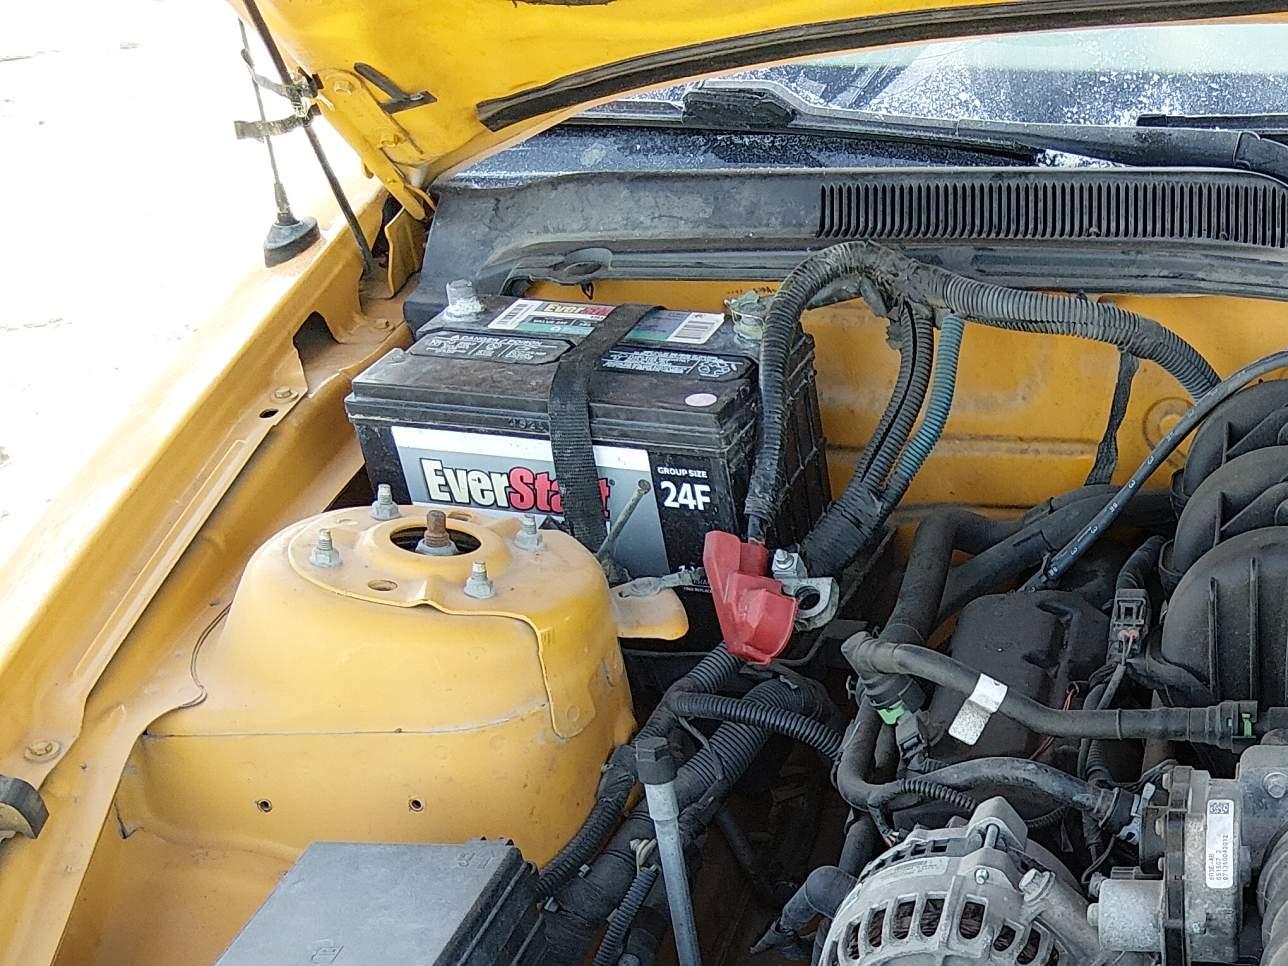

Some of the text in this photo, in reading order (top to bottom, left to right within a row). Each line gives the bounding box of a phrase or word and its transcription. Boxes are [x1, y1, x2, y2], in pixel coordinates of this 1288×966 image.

[420, 457, 612, 519] EverStat
[657, 466, 709, 479] GROUP SIZE
[660, 480, 711, 511] 24F
